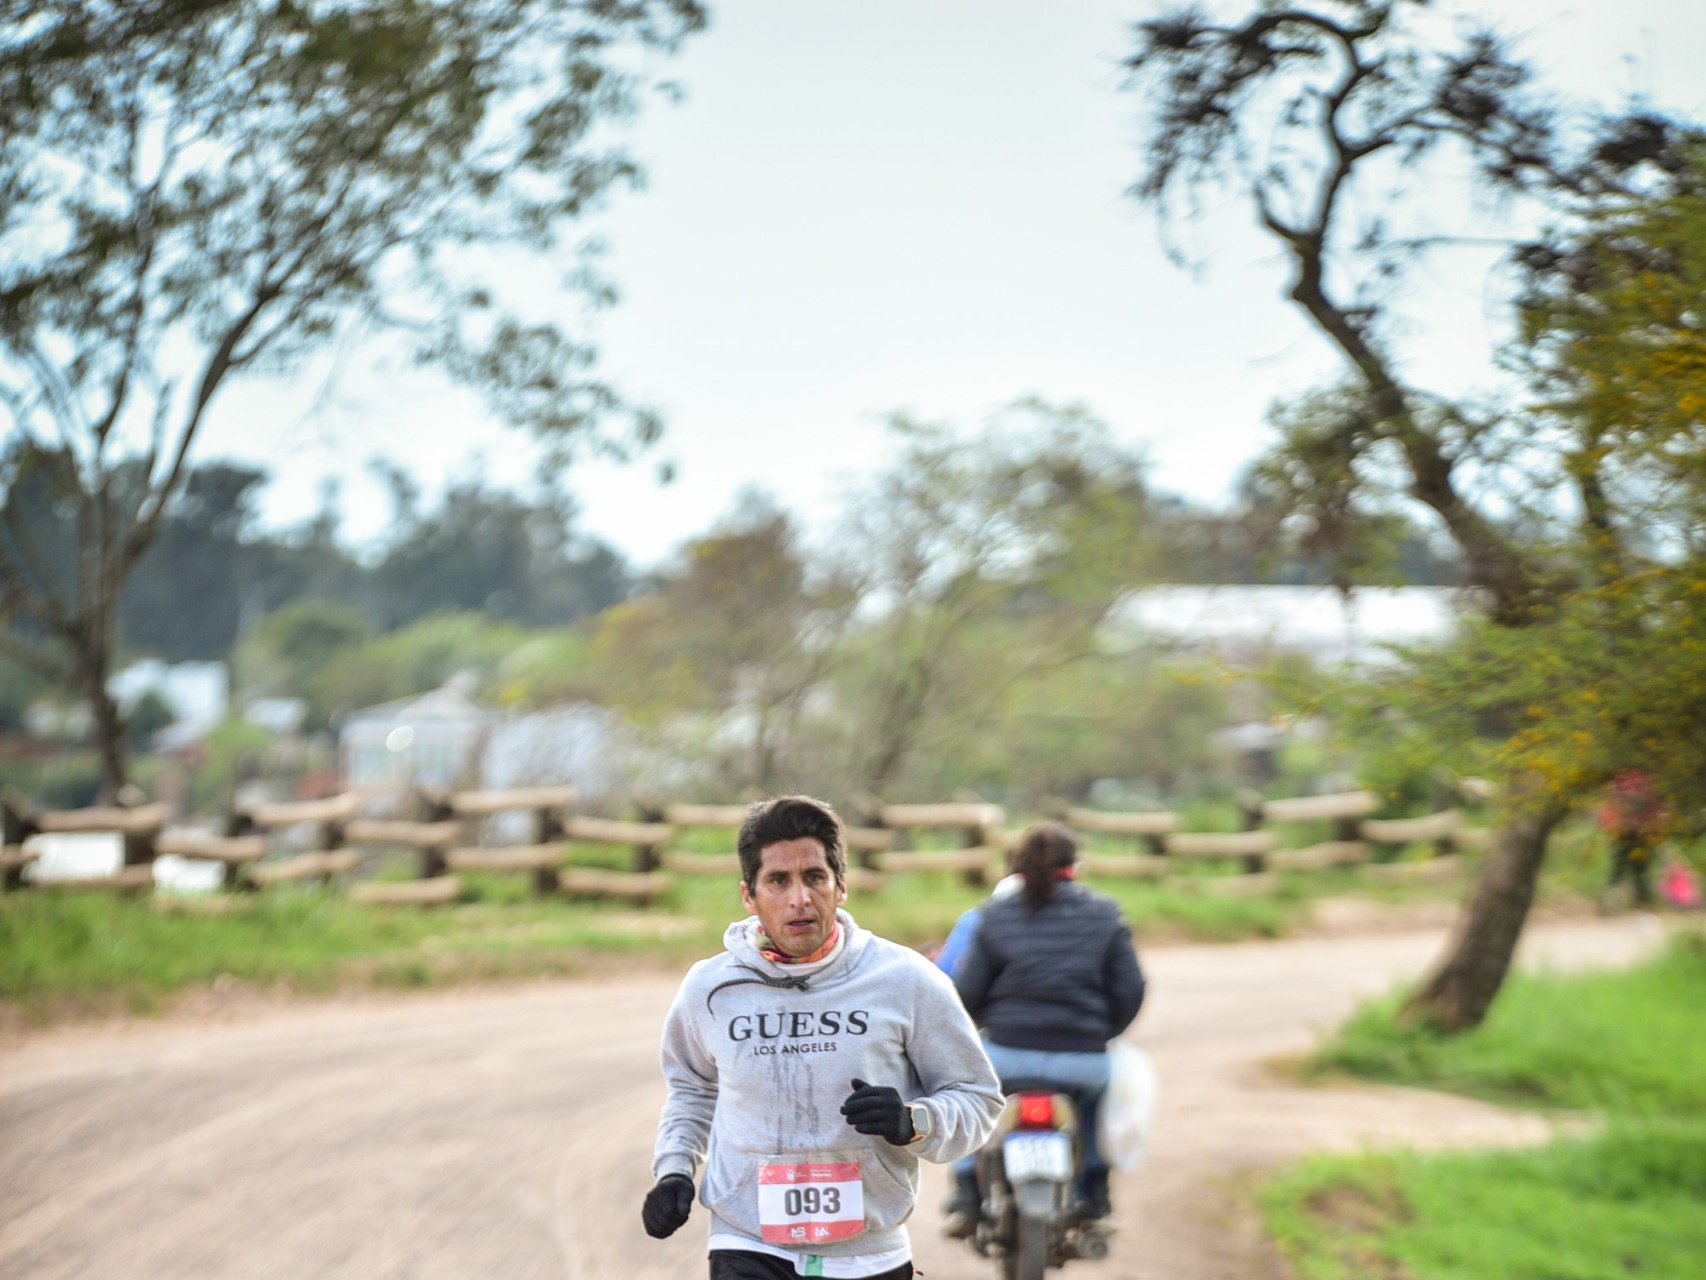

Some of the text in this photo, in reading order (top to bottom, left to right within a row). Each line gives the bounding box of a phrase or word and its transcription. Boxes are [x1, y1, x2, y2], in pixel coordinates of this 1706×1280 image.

[728, 1010, 869, 1042] GUESS
[754, 1042, 837, 1056] LOS ANGELES
[785, 1187, 840, 1216] 093
